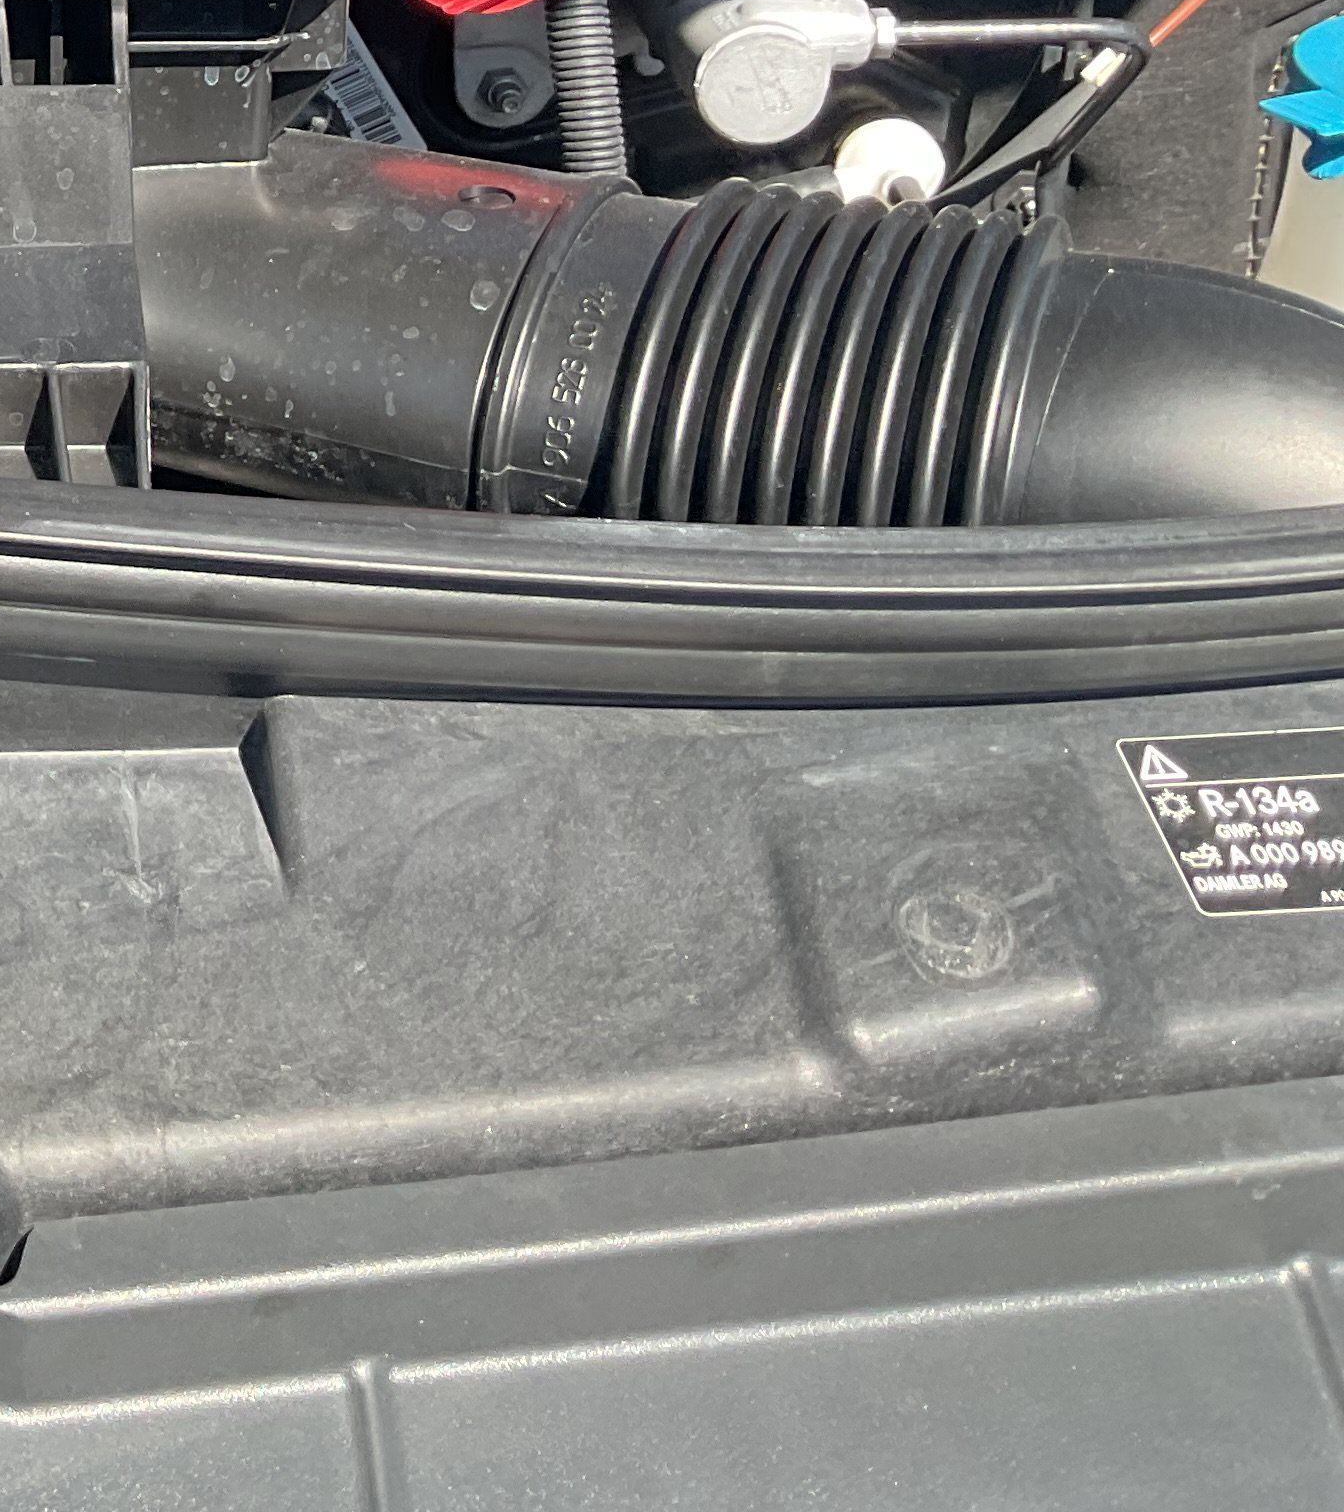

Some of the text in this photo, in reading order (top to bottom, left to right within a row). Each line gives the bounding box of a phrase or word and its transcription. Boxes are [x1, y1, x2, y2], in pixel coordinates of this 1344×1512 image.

[541, 415, 577, 467] 906
[1198, 784, 1321, 818] R-134a
[1215, 820, 1305, 839] GWP: 1430
[1230, 844, 1251, 866] A
[1250, 842, 1300, 865] 000
[1193, 872, 1289, 893] DAIMLER AG
